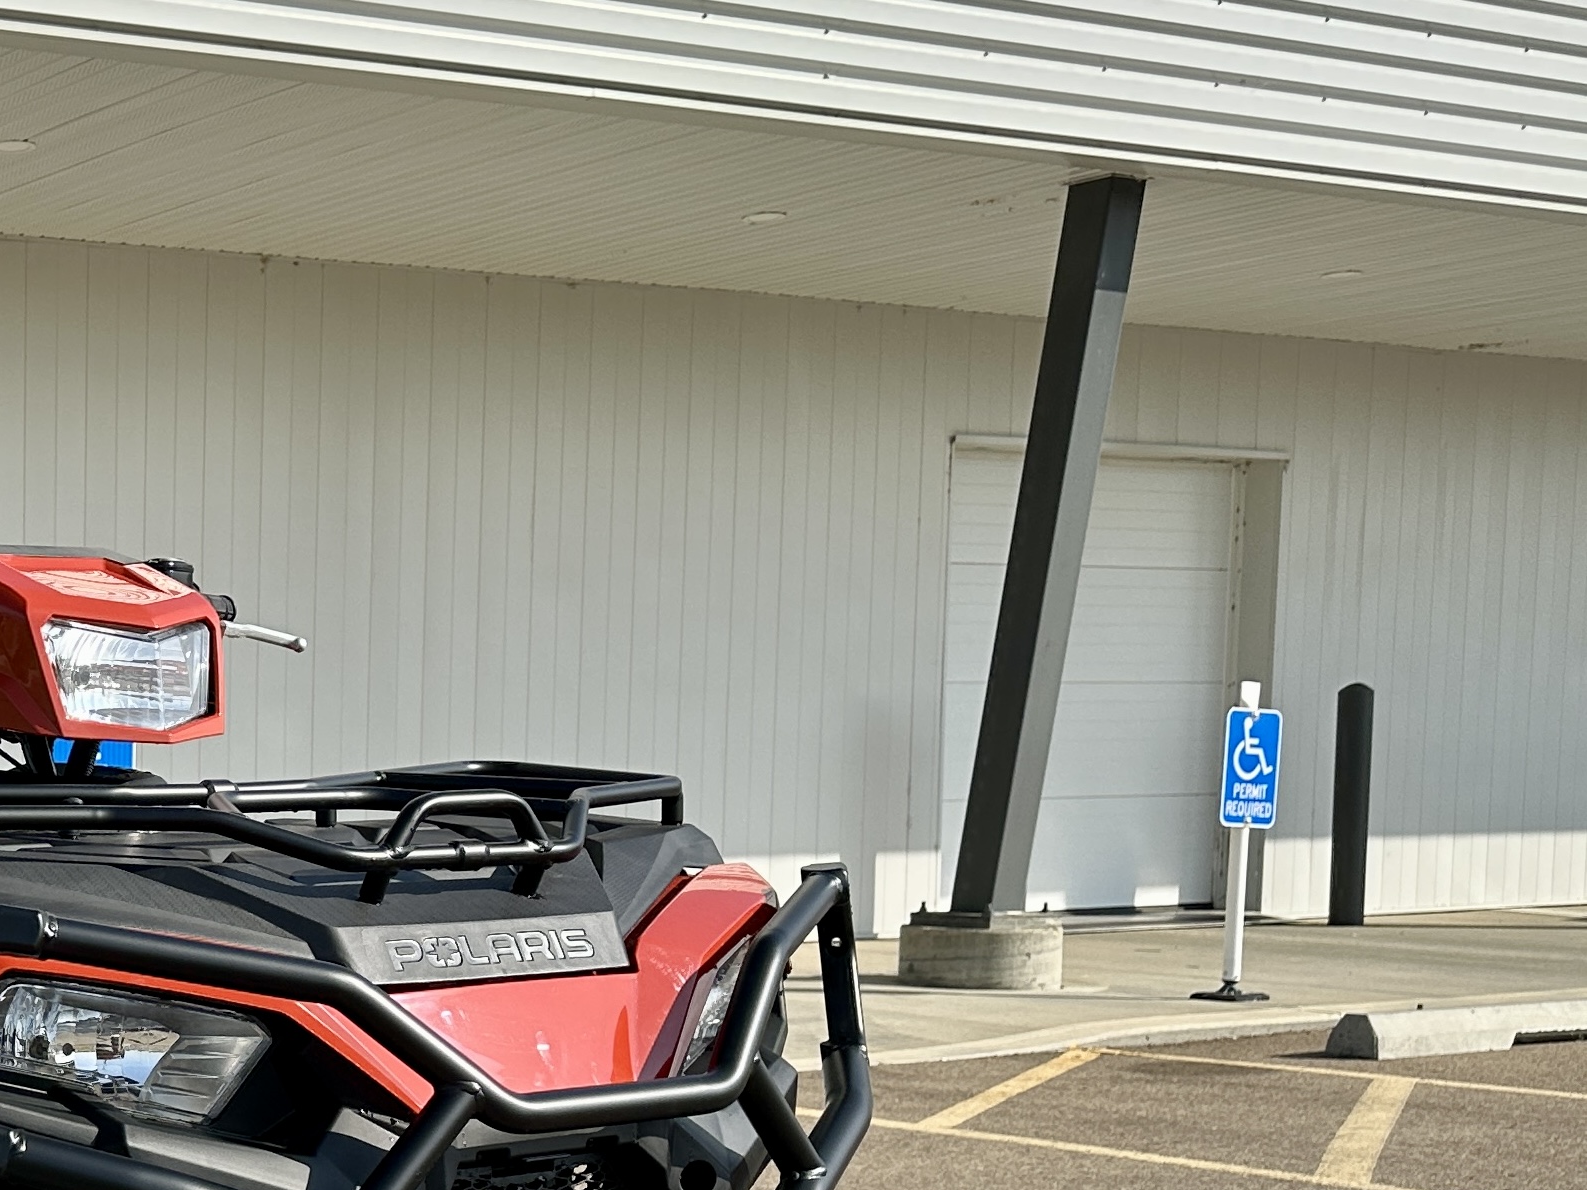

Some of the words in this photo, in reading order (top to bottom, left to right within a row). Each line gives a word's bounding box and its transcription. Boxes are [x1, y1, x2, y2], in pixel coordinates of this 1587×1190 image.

[1233, 782, 1268, 799] PERMIT
[1225, 800, 1272, 818] REQUIRED
[385, 929, 595, 972] POLARIS
